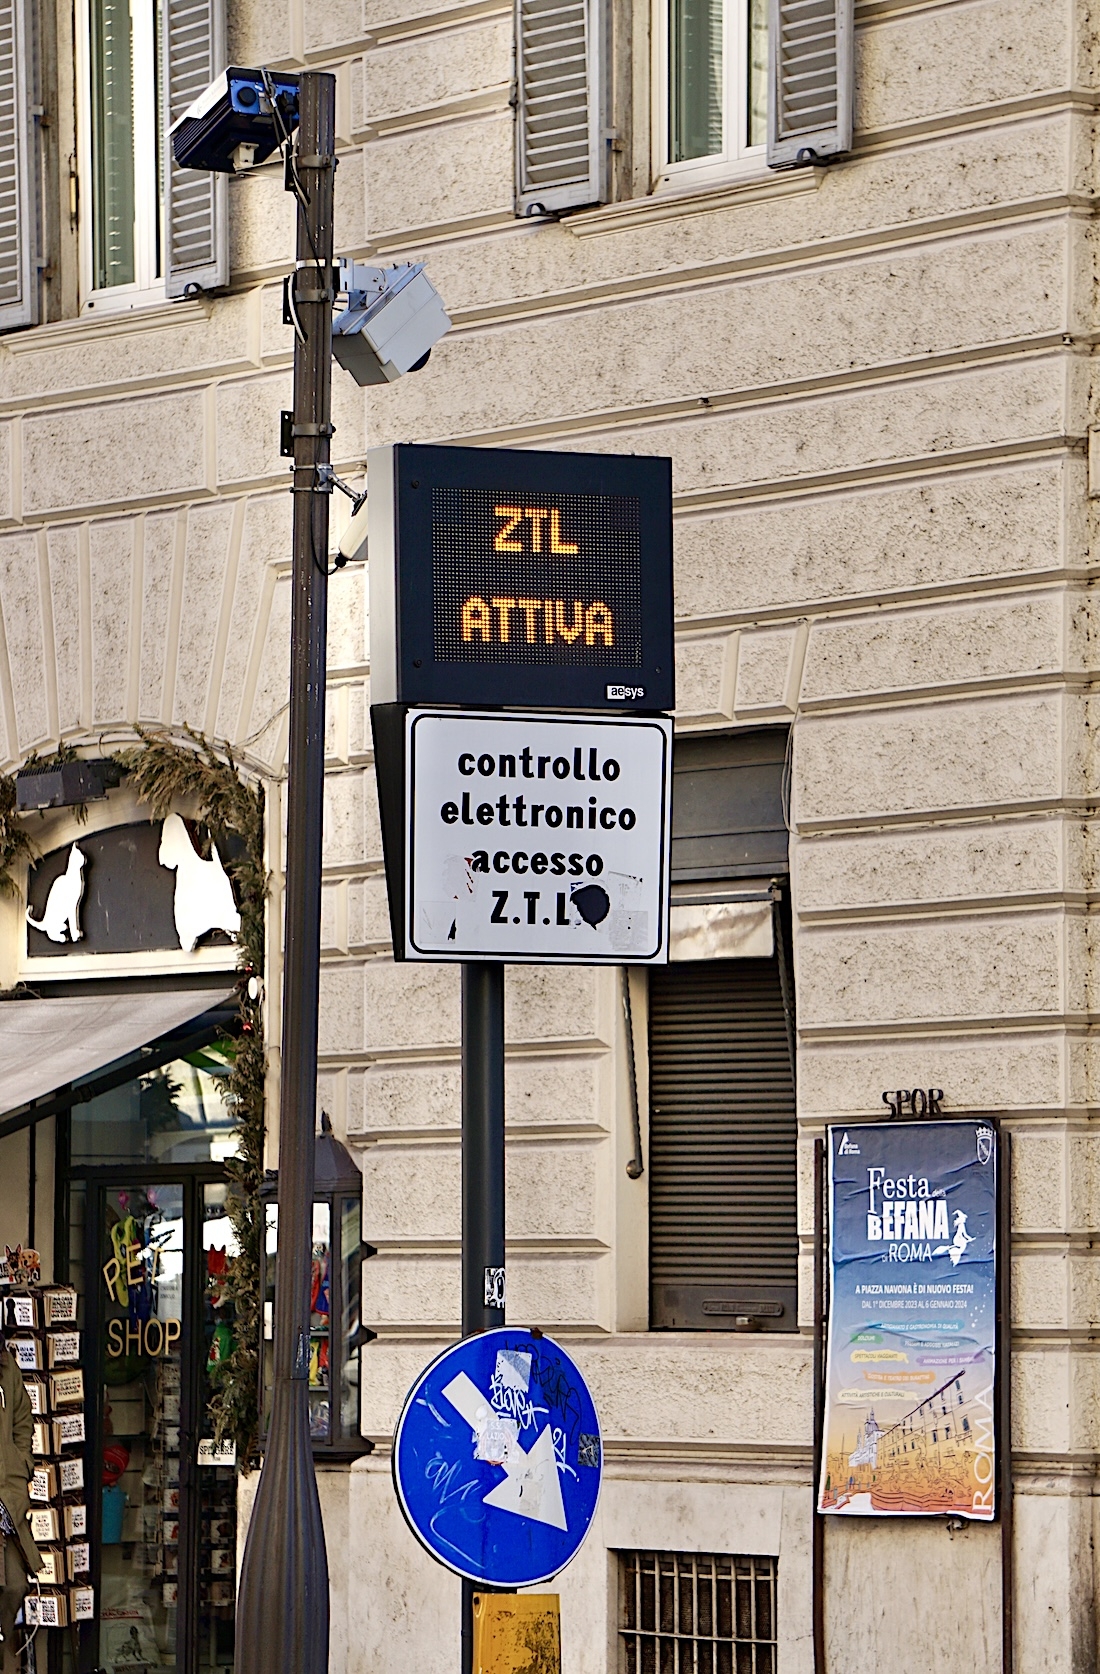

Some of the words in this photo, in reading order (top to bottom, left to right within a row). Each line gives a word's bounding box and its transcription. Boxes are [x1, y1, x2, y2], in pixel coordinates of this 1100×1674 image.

[494, 506, 579, 555] ZTL
[462, 597, 614, 647] ATTIVA
[611, 687, 644, 699] aesys
[458, 746, 621, 781] controllo
[440, 791, 636, 830] elettronico
[471, 850, 604, 876] accesso
[867, 1168, 931, 1213] Festa
[867, 1200, 949, 1240] BEFANA
[889, 1243, 932, 1262] ROMA
[103, 1243, 164, 1302] PET
[855, 1285, 861, 1294] A
[862, 1285, 883, 1294] PIAZZA
[884, 1285, 912, 1294] NAVONA
[918, 1285, 926, 1294] DI
[927, 1285, 951, 1294] NUOVO
[953, 1285, 974, 1294] FESTA!
[862, 1300, 872, 1309] DAL
[879, 1300, 904, 1309] DICEMBRE
[905, 1300, 917, 1309] 2023
[918, 1300, 925, 1309] AL
[930, 1300, 954, 1309] GENNAIO
[954, 1300, 967, 1309] 2024
[107, 1318, 181, 1357] SHOP
[972, 1384, 993, 1510] ROMA
